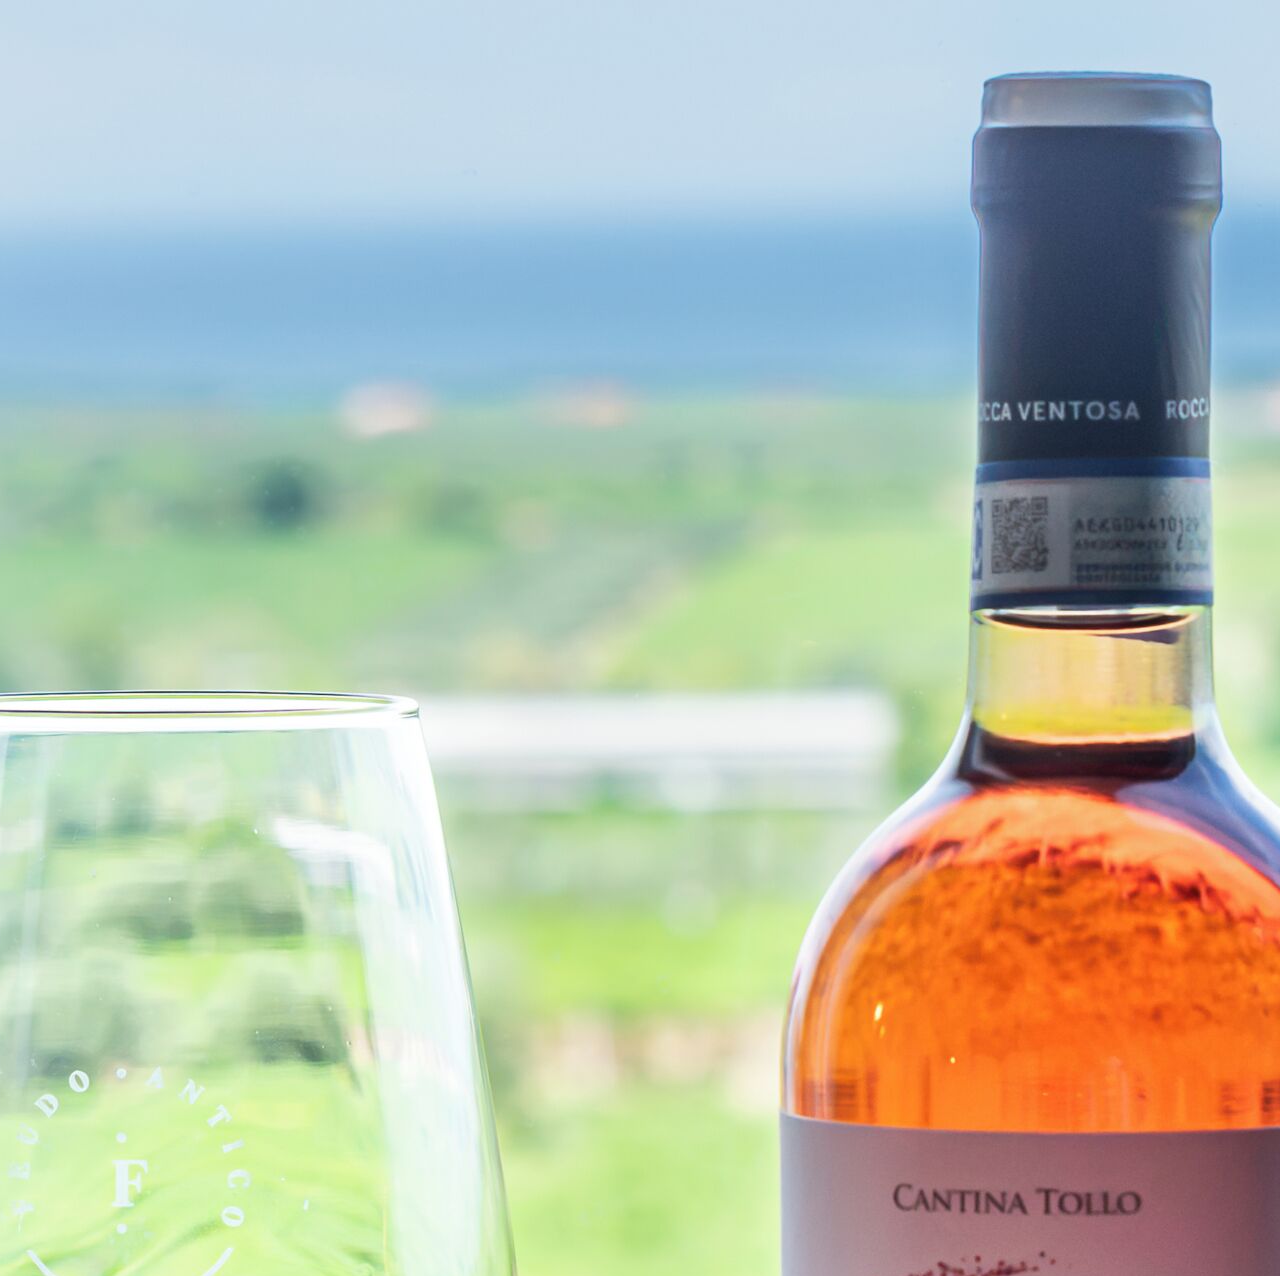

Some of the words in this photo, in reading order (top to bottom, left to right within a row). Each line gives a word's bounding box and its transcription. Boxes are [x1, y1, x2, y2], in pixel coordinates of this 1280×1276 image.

[1018, 400, 1140, 421] VENTOSA
[145, 1066, 251, 1227] ANTICO
[112, 1159, 148, 1207] F
